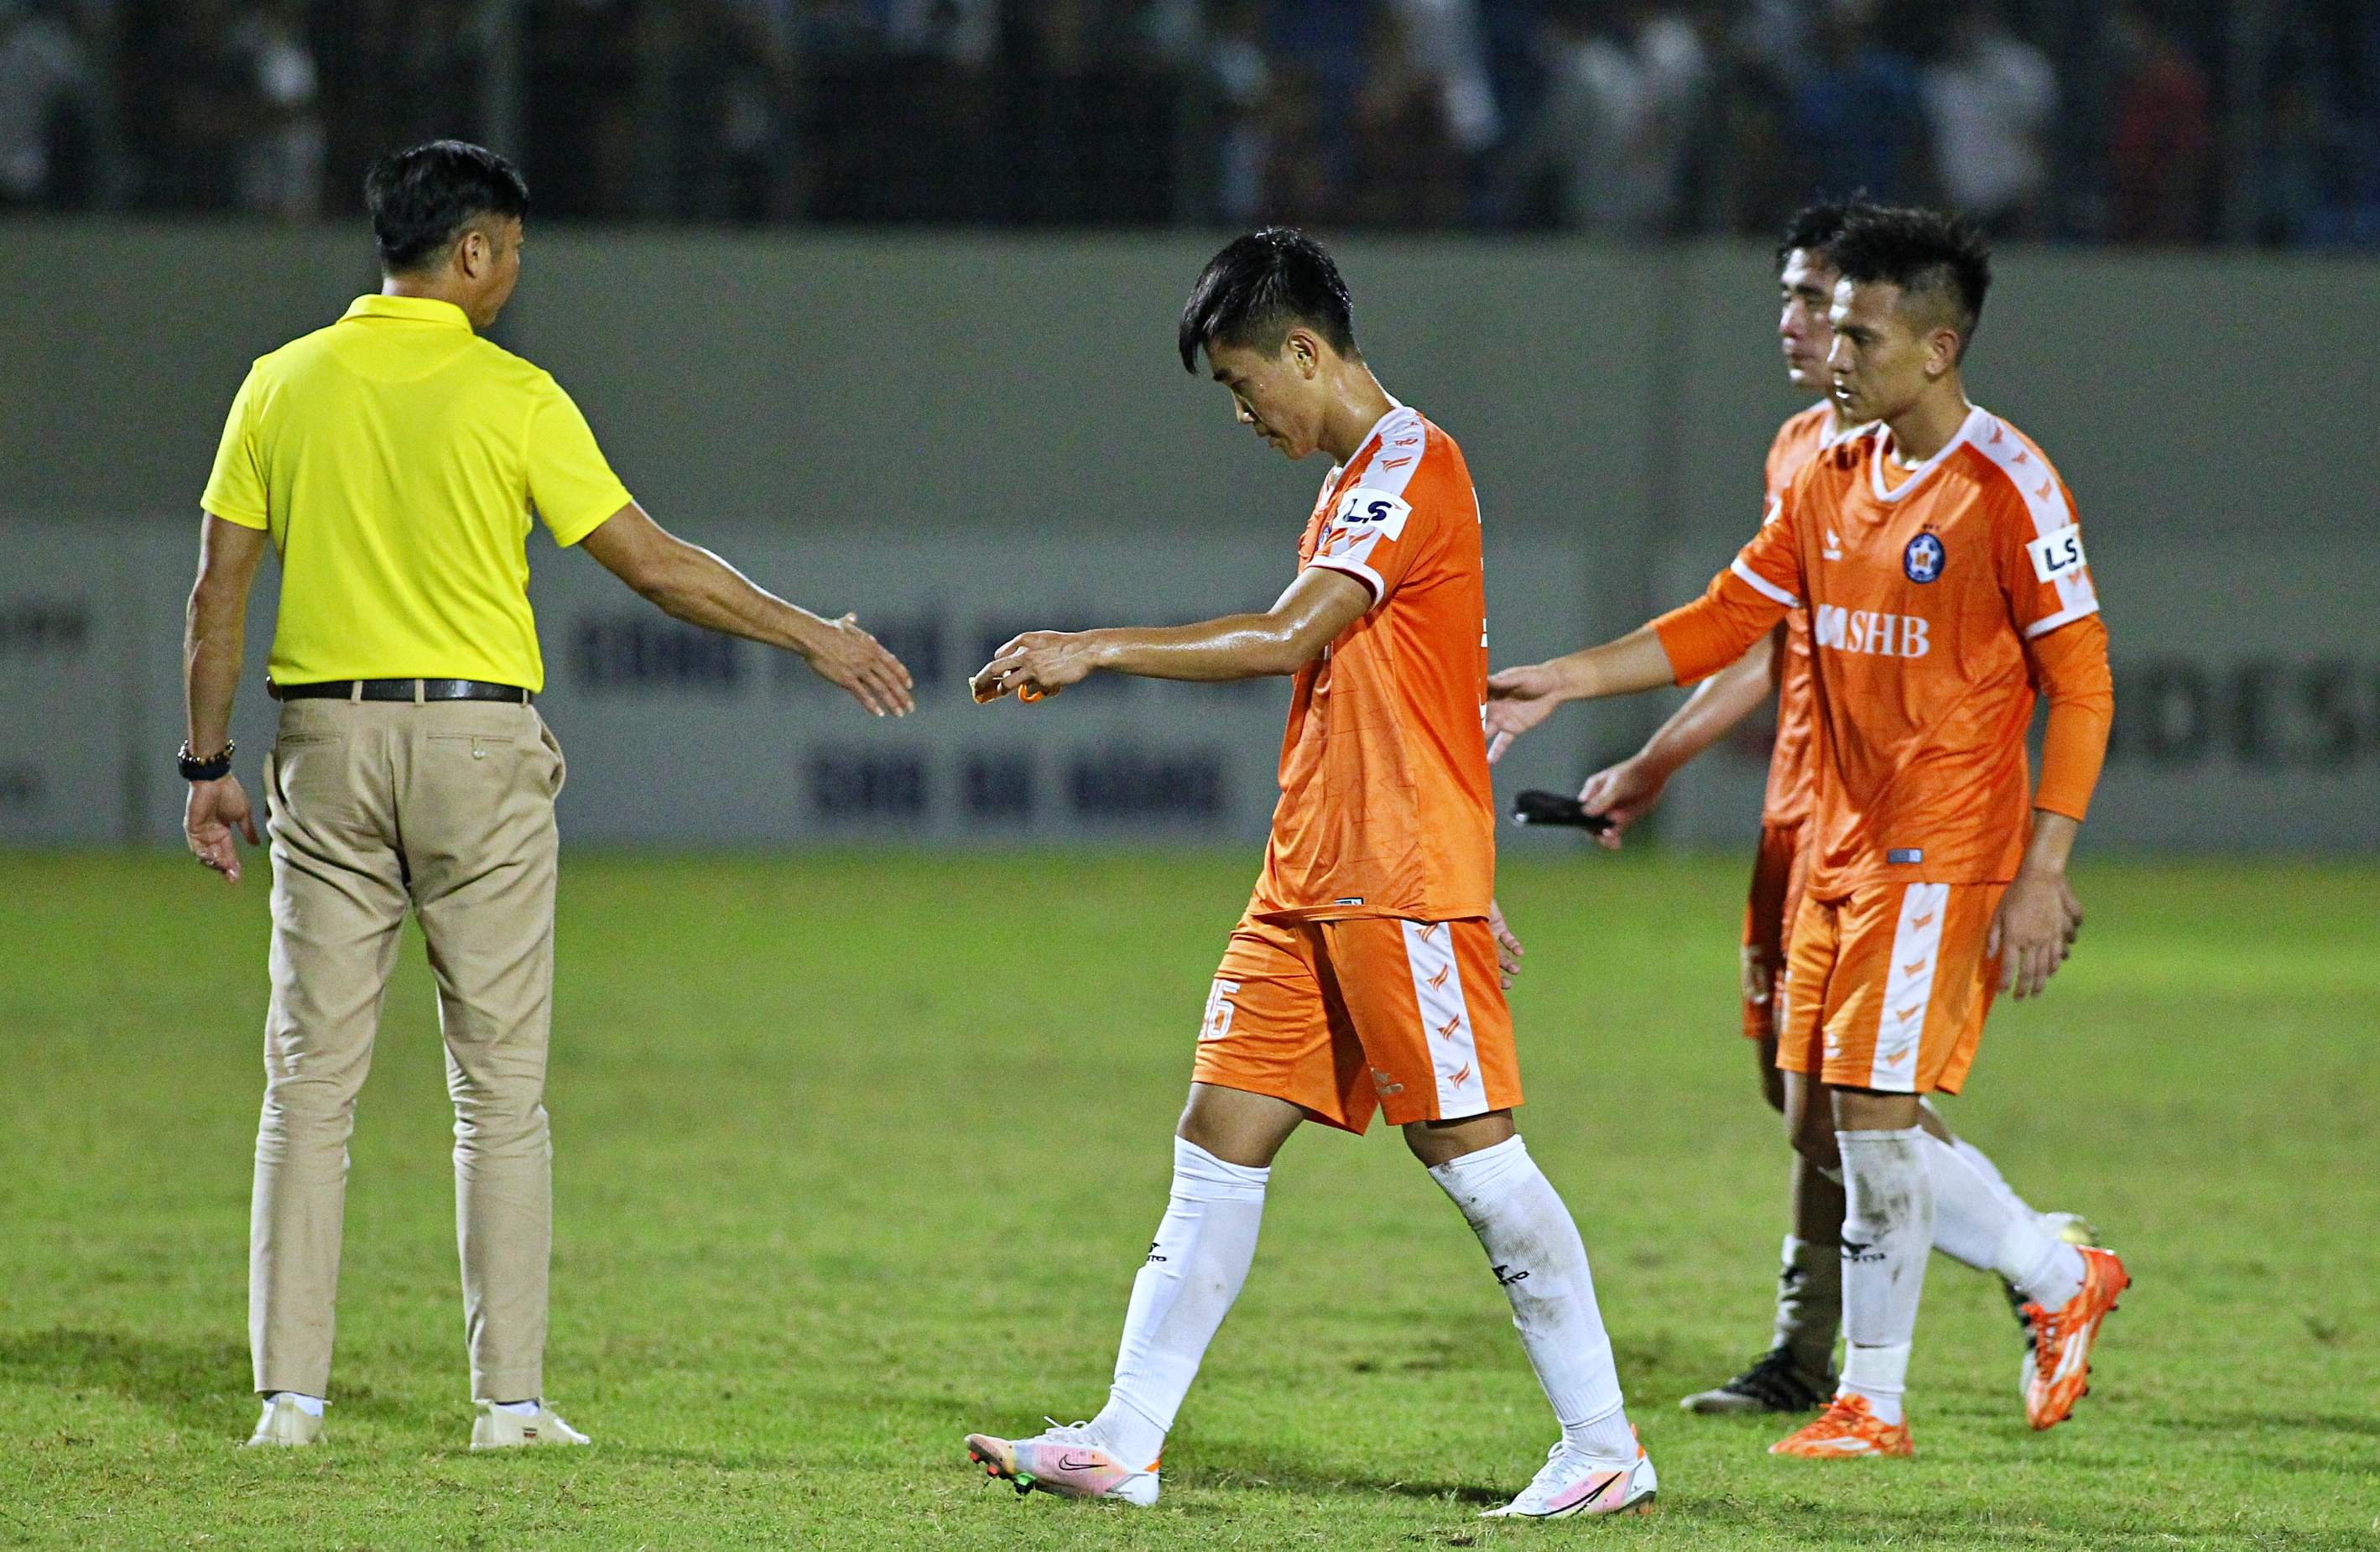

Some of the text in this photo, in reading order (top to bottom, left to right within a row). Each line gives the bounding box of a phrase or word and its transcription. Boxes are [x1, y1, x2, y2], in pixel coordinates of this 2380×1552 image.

[1342, 498, 1393, 523] LS
[2044, 538, 2078, 571] LS
[1846, 609, 1931, 659] SHB
